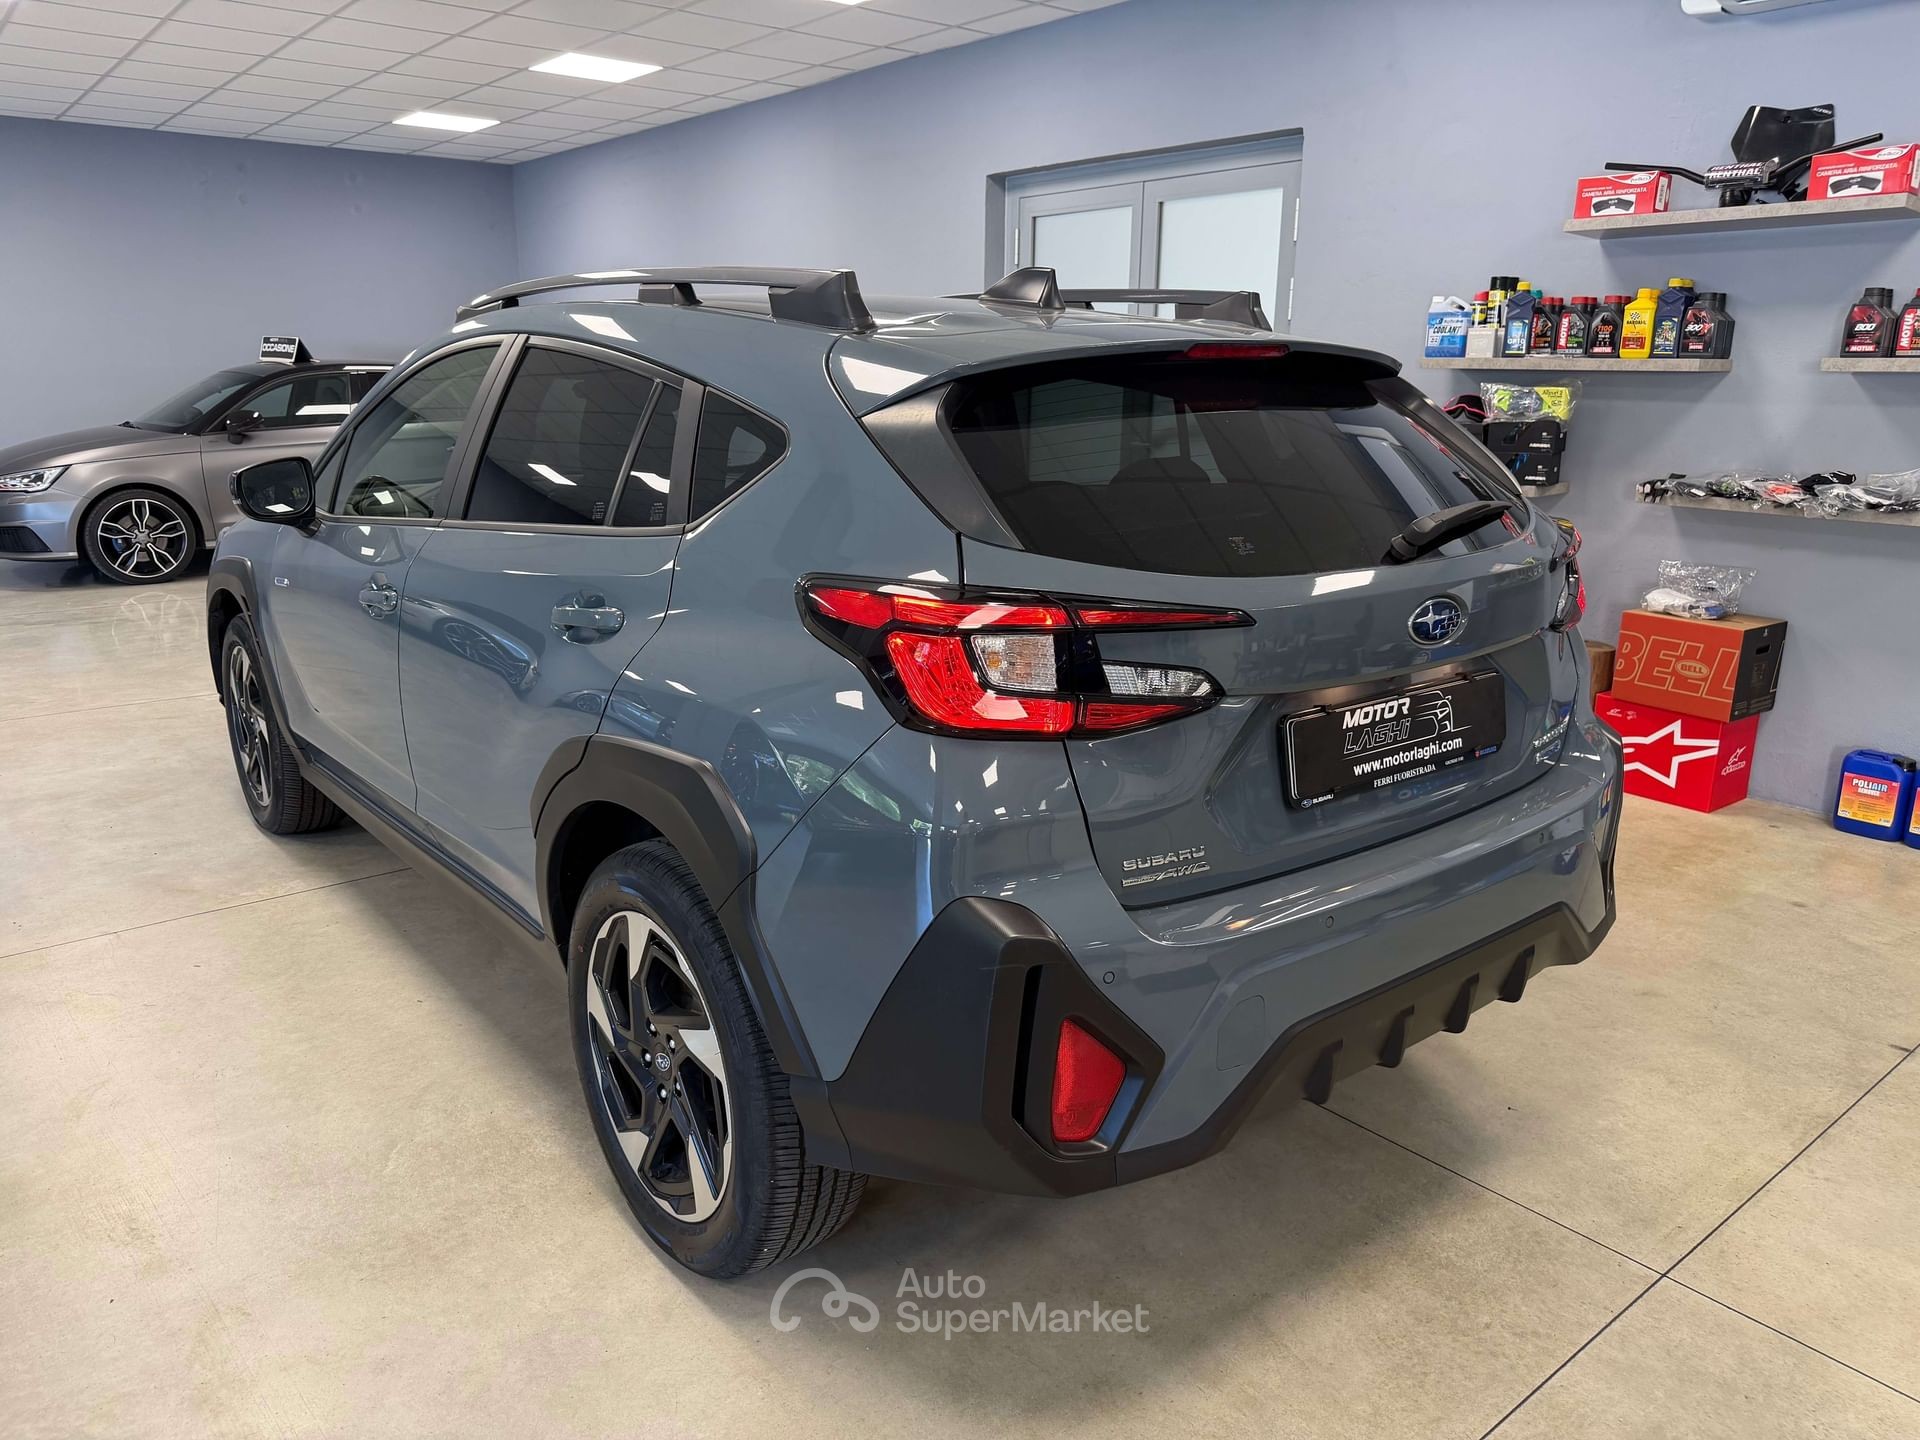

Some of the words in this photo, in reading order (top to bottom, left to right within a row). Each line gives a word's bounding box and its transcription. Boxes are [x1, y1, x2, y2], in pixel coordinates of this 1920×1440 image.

[1704, 167, 1761, 179] RENTHAL
[1814, 168, 1842, 177] CAMERA
[1433, 326, 1462, 334] COOLANT
[1560, 316, 1568, 346] MOTUL
[1900, 313, 1914, 348] MOTUL
[262, 343, 295, 353] OCCASIONE
[1679, 662, 1704, 675] BELL
[1342, 697, 1411, 730] MOTOR
[1353, 737, 1463, 777] www.motorlaghi.com
[1373, 775, 1393, 788] FERRI
[1394, 763, 1437, 781] FUORISTRADA
[1852, 778, 1889, 792] POLIAIR
[1122, 846, 1205, 871] SUBARU
